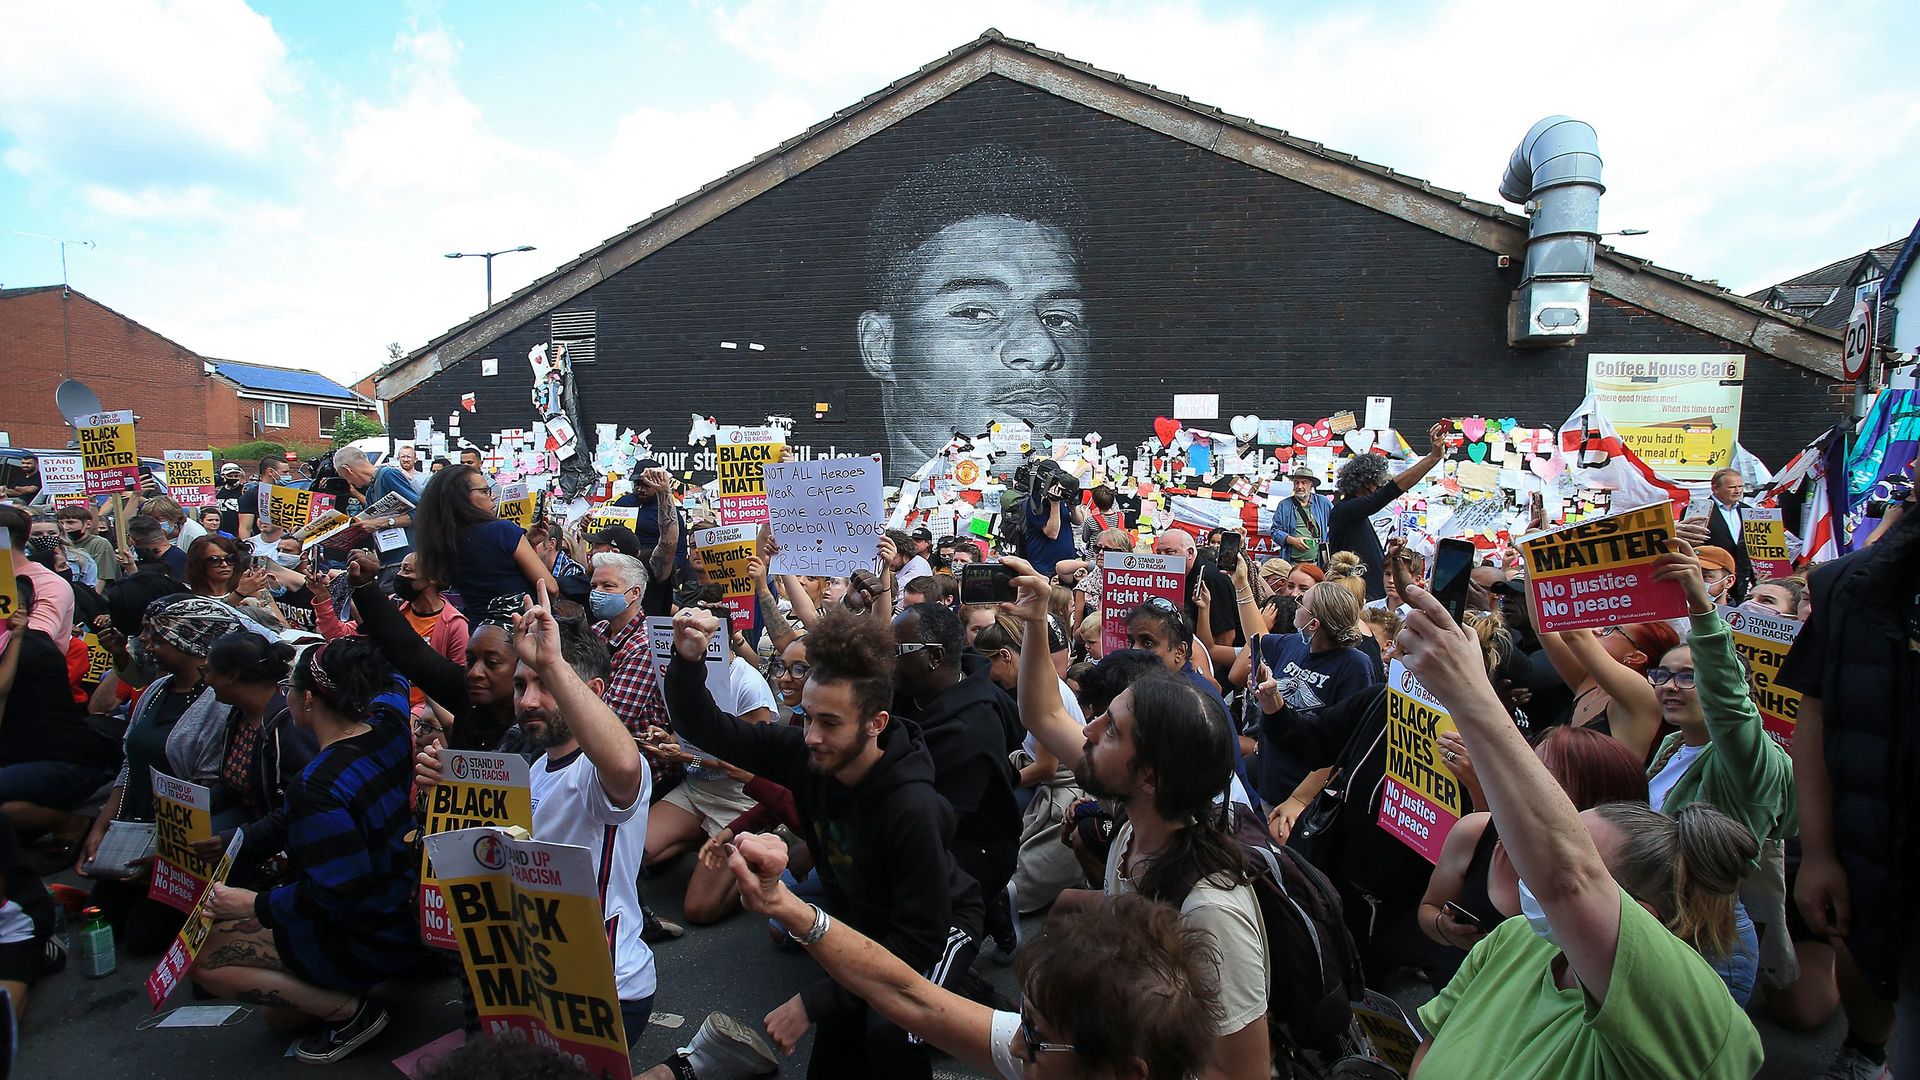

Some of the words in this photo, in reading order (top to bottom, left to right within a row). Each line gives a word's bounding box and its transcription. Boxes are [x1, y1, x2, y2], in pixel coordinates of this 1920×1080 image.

[1846, 322, 1866, 359] 20
[1595, 362, 1644, 376] Coffee
[1648, 362, 1696, 376] House
[1618, 395, 1634, 403] good
[81, 426, 119, 441] BLACK
[1637, 435, 1653, 445] you
[1656, 434, 1672, 443] had
[83, 440, 115, 454] LIVES
[720, 445, 771, 462] BLACK
[1645, 449, 1666, 458] meal
[1670, 448, 1679, 458] of
[1710, 449, 1726, 461] ay?
[85, 452, 133, 468] MATTER
[87, 471, 98, 480] No
[721, 462, 763, 478] LIVES
[764, 467, 785, 480] NOT
[792, 468, 812, 480] ALL
[88, 480, 99, 488] No
[722, 478, 764, 493] MATT
[271, 496, 283, 526] BLACK
[500, 502, 524, 517] LACK
[724, 499, 736, 508] No
[738, 498, 768, 509] justic
[724, 509, 737, 518] No
[739, 508, 765, 520] peace
[1744, 522, 1771, 533] BLACK
[1745, 534, 1767, 545] LIVES
[701, 545, 752, 566] Migrants
[1531, 529, 1669, 573] MATTER
[1747, 545, 1785, 558] MATTER
[708, 564, 736, 580] make
[730, 576, 751, 593] NHS
[1107, 572, 1152, 587] Defend
[1156, 575, 1178, 589] the
[1539, 581, 1565, 598] No
[1570, 572, 1638, 599] justice
[1106, 589, 1139, 604] right
[1542, 600, 1568, 617] No
[1574, 594, 1632, 617] peace
[1748, 616, 1777, 630] STAND
[1780, 621, 1794, 632] UP
[1748, 625, 1760, 634] TO
[655, 640, 670, 650] Sat
[89, 652, 106, 681] LIVES
[1414, 687, 1422, 696] TO
[1758, 688, 1800, 720] NHS
[1390, 692, 1441, 740] BLACK
[1390, 720, 1434, 766] LIVES
[469, 758, 492, 769] STAND
[494, 760, 504, 770] UP
[471, 769, 480, 779] TO
[482, 770, 510, 782] RACISM
[1390, 746, 1456, 810] MATTER
[168, 782, 183, 792] STAND
[168, 788, 174, 797] TO
[175, 792, 194, 804] RACISM
[433, 784, 508, 820] BLACK
[1386, 779, 1399, 802] No
[1400, 789, 1436, 825] justice
[1383, 799, 1397, 819] No
[1398, 810, 1429, 840] peace
[505, 846, 528, 866] TAND
[532, 851, 550, 866] UP
[157, 860, 169, 875] No
[170, 867, 195, 890] justice
[515, 867, 562, 886] RACISM
[155, 874, 167, 889] No
[170, 884, 192, 901] peace
[425, 889, 443, 909] No
[426, 910, 443, 929] No
[450, 881, 568, 943] BLACK
[464, 924, 557, 986] LIVES
[476, 968, 619, 1043] MATTER
[490, 1020, 527, 1044] No
